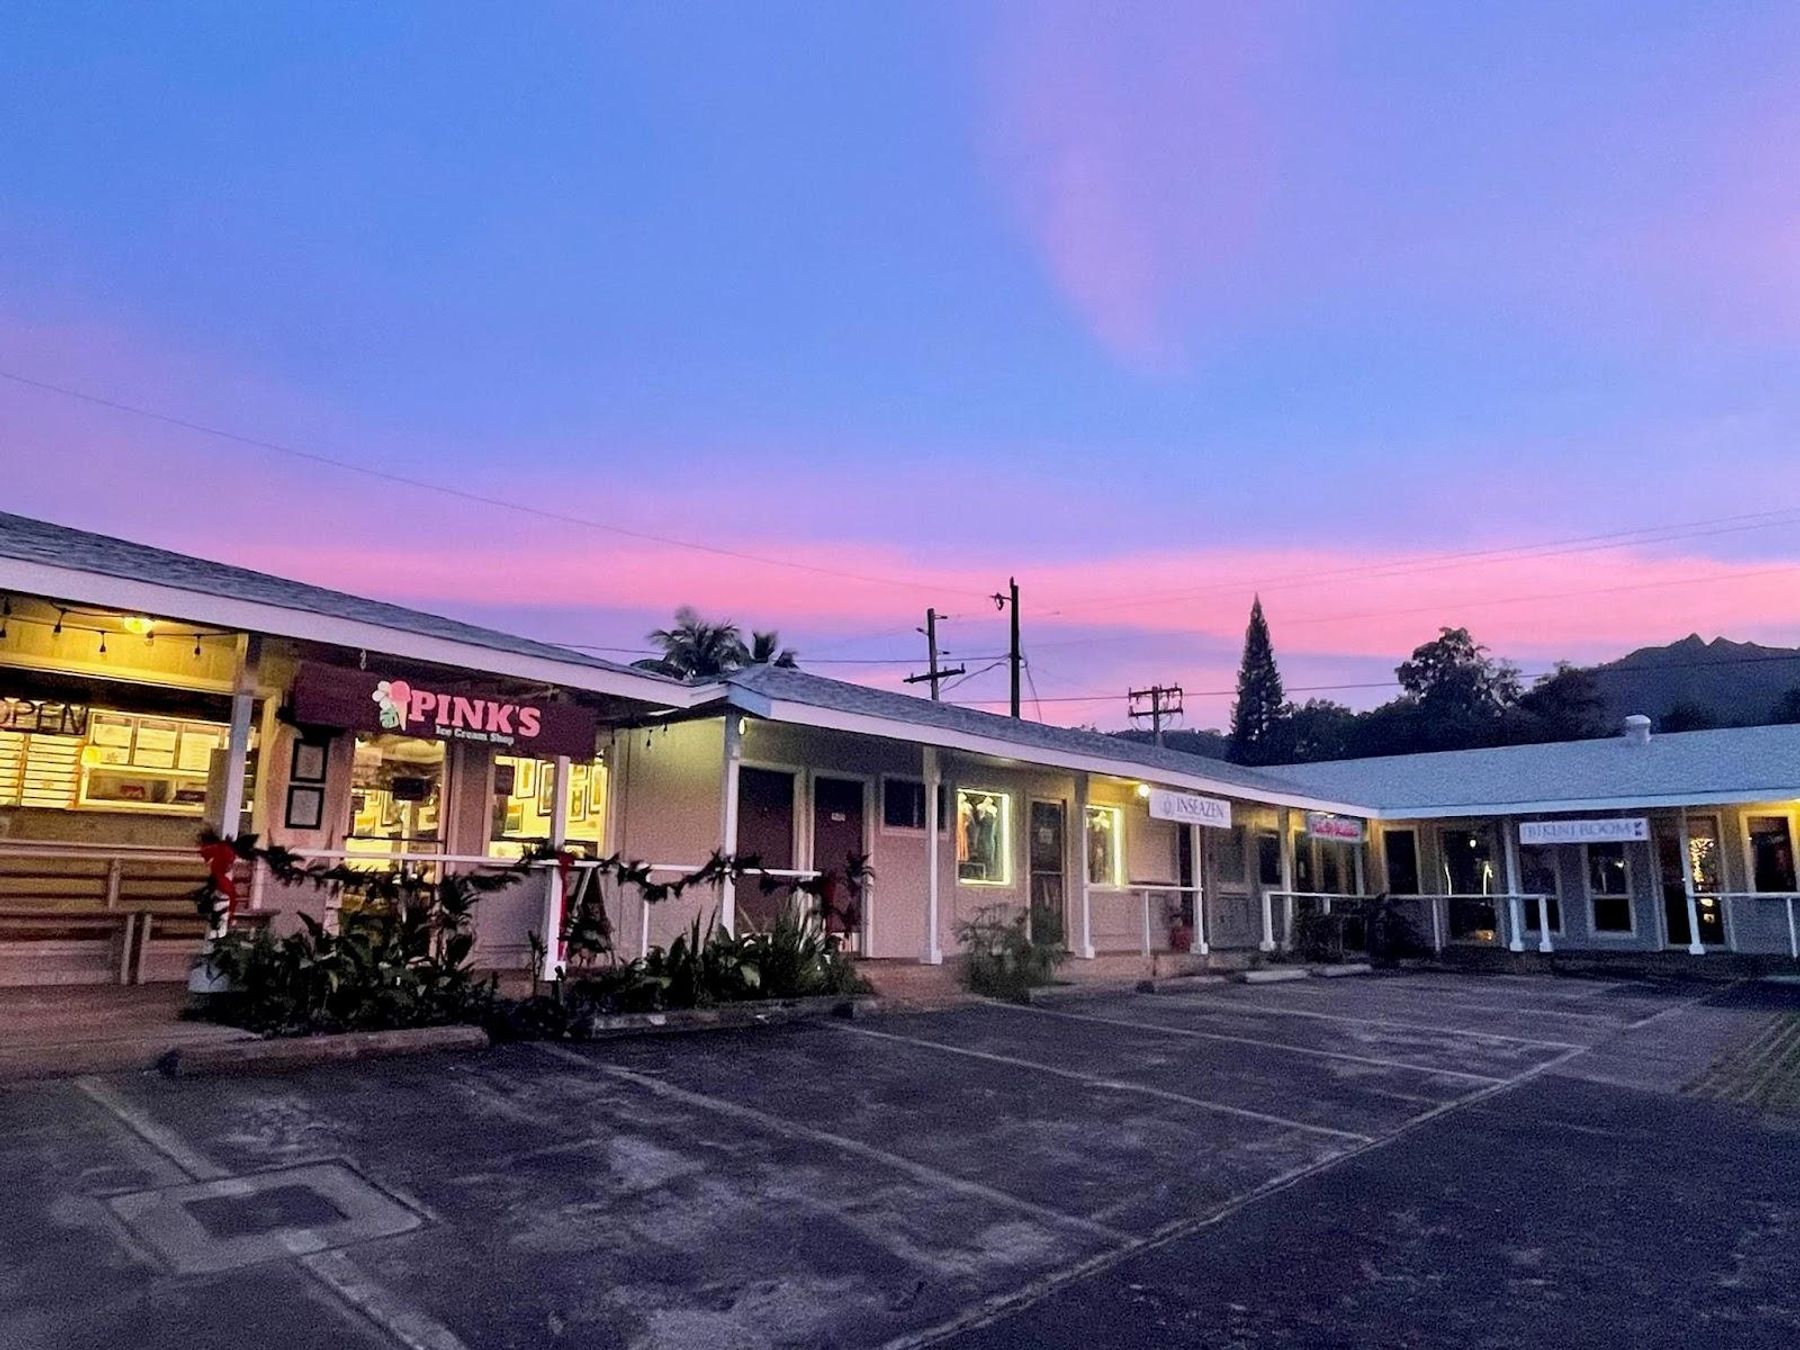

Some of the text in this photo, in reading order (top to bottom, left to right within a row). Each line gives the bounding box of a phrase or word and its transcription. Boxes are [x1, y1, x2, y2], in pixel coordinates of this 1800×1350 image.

[408, 689, 541, 737] PINK'S
[435, 725, 515, 746] Ice Cream Shop
[1527, 823, 1576, 837] BIKINI
[1580, 821, 1632, 836] ROOM
